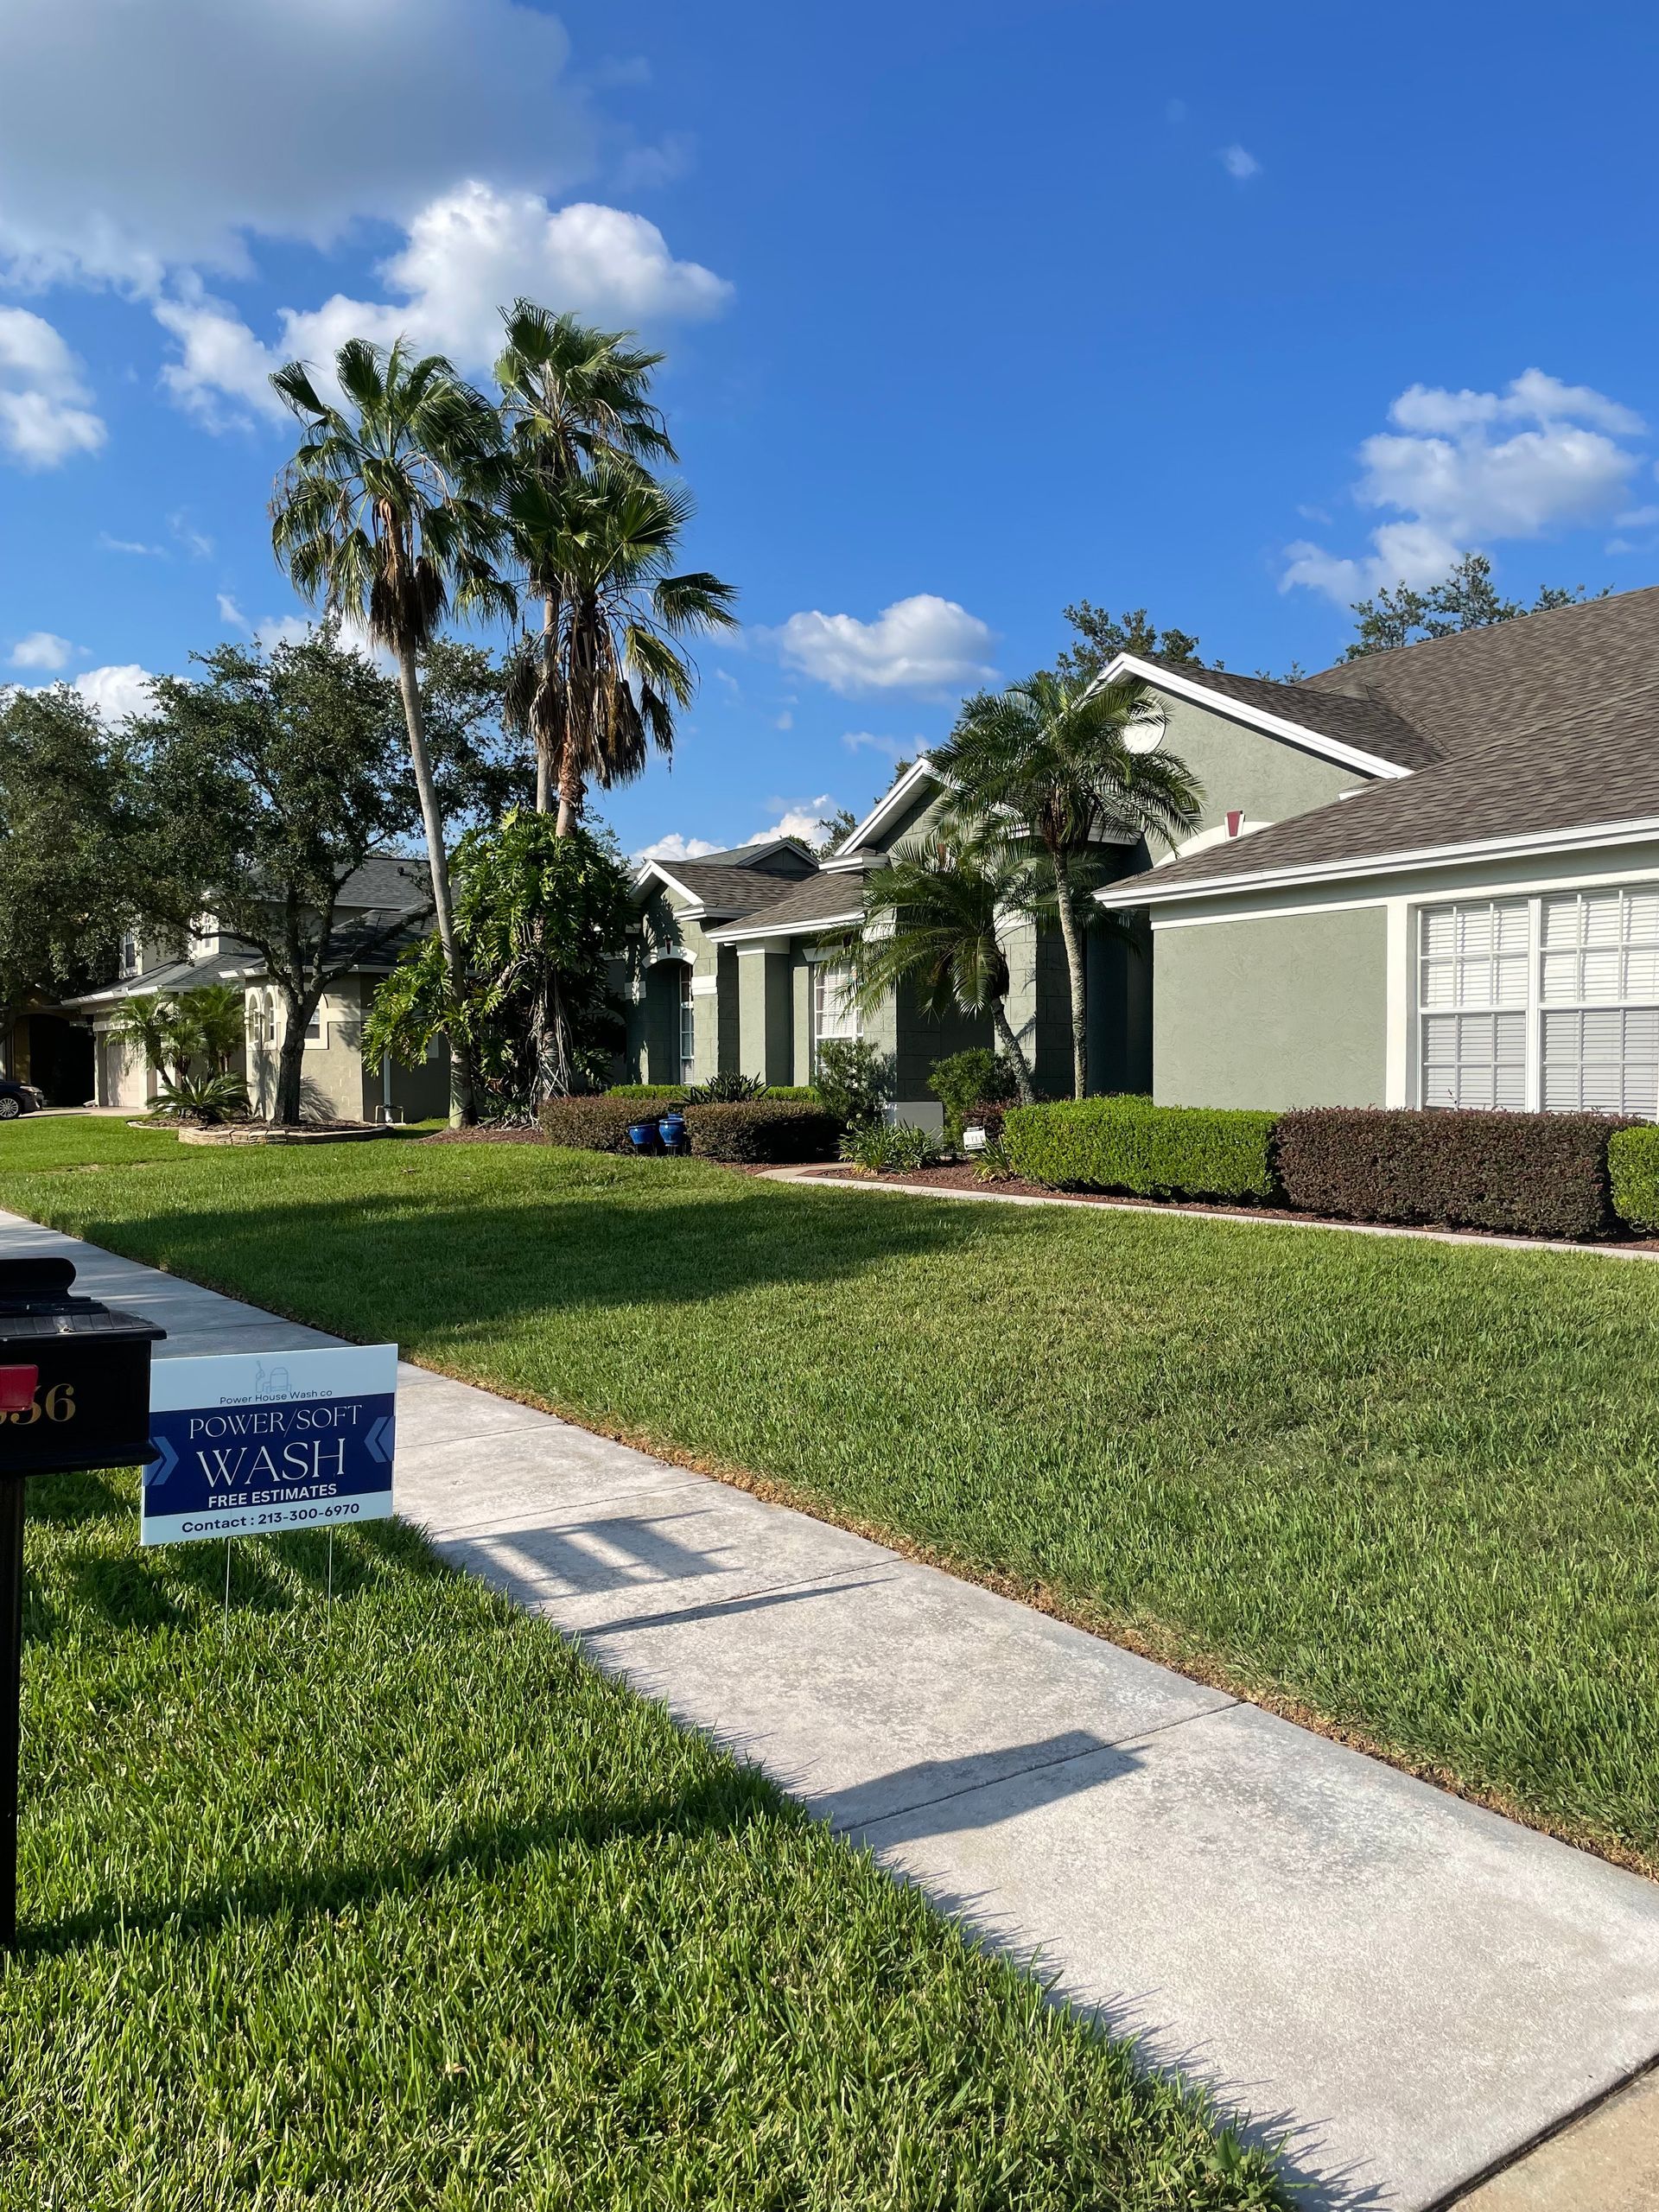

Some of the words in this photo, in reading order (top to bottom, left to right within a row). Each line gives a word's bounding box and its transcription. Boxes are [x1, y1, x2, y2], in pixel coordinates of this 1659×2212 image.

[219, 1395, 252, 1405] Power
[255, 1393, 287, 1402] House
[289, 1389, 318, 1400] Wash
[189, 1404, 363, 1440] POWER/SOFT
[195, 1438, 346, 1488] WASH
[208, 1493, 247, 1509] FREE
[251, 1483, 338, 1504] ESTIMATES
[181, 1516, 247, 1533] Contact
[257, 1503, 359, 1525] 213-300-6970
